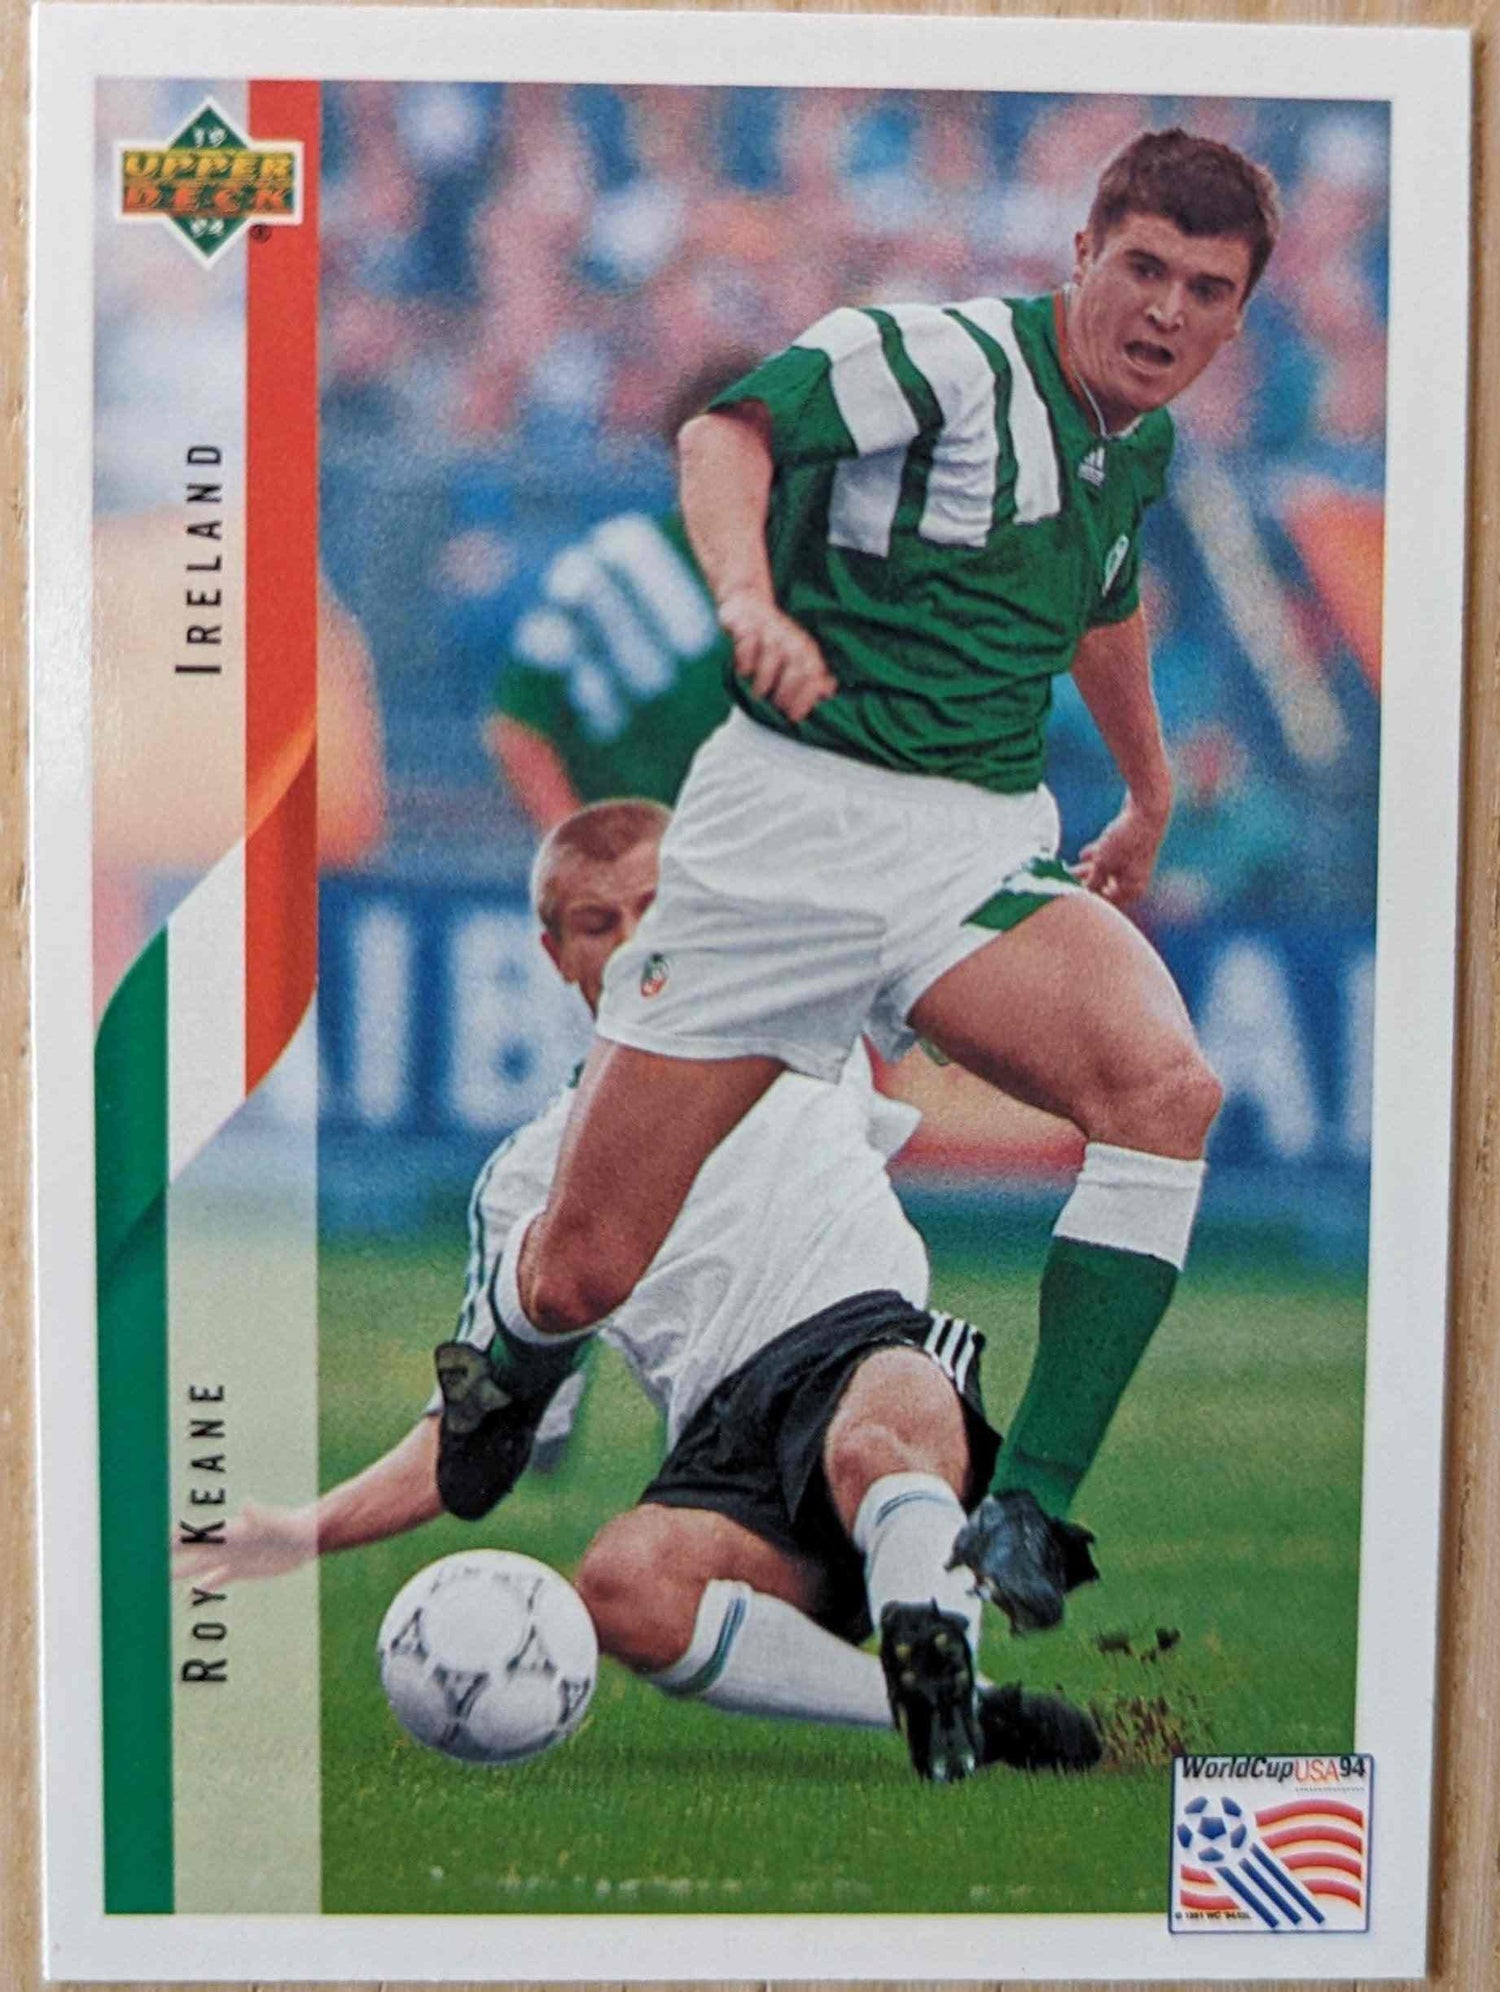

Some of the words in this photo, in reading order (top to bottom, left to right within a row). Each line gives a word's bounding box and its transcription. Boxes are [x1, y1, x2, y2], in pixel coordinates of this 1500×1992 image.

[124, 152, 292, 181] UPPER
[124, 183, 289, 214] DECK
[174, 445, 223, 674] IRELAND
[178, 1384, 226, 1545] KEANE
[180, 1586, 228, 1683] ROY
